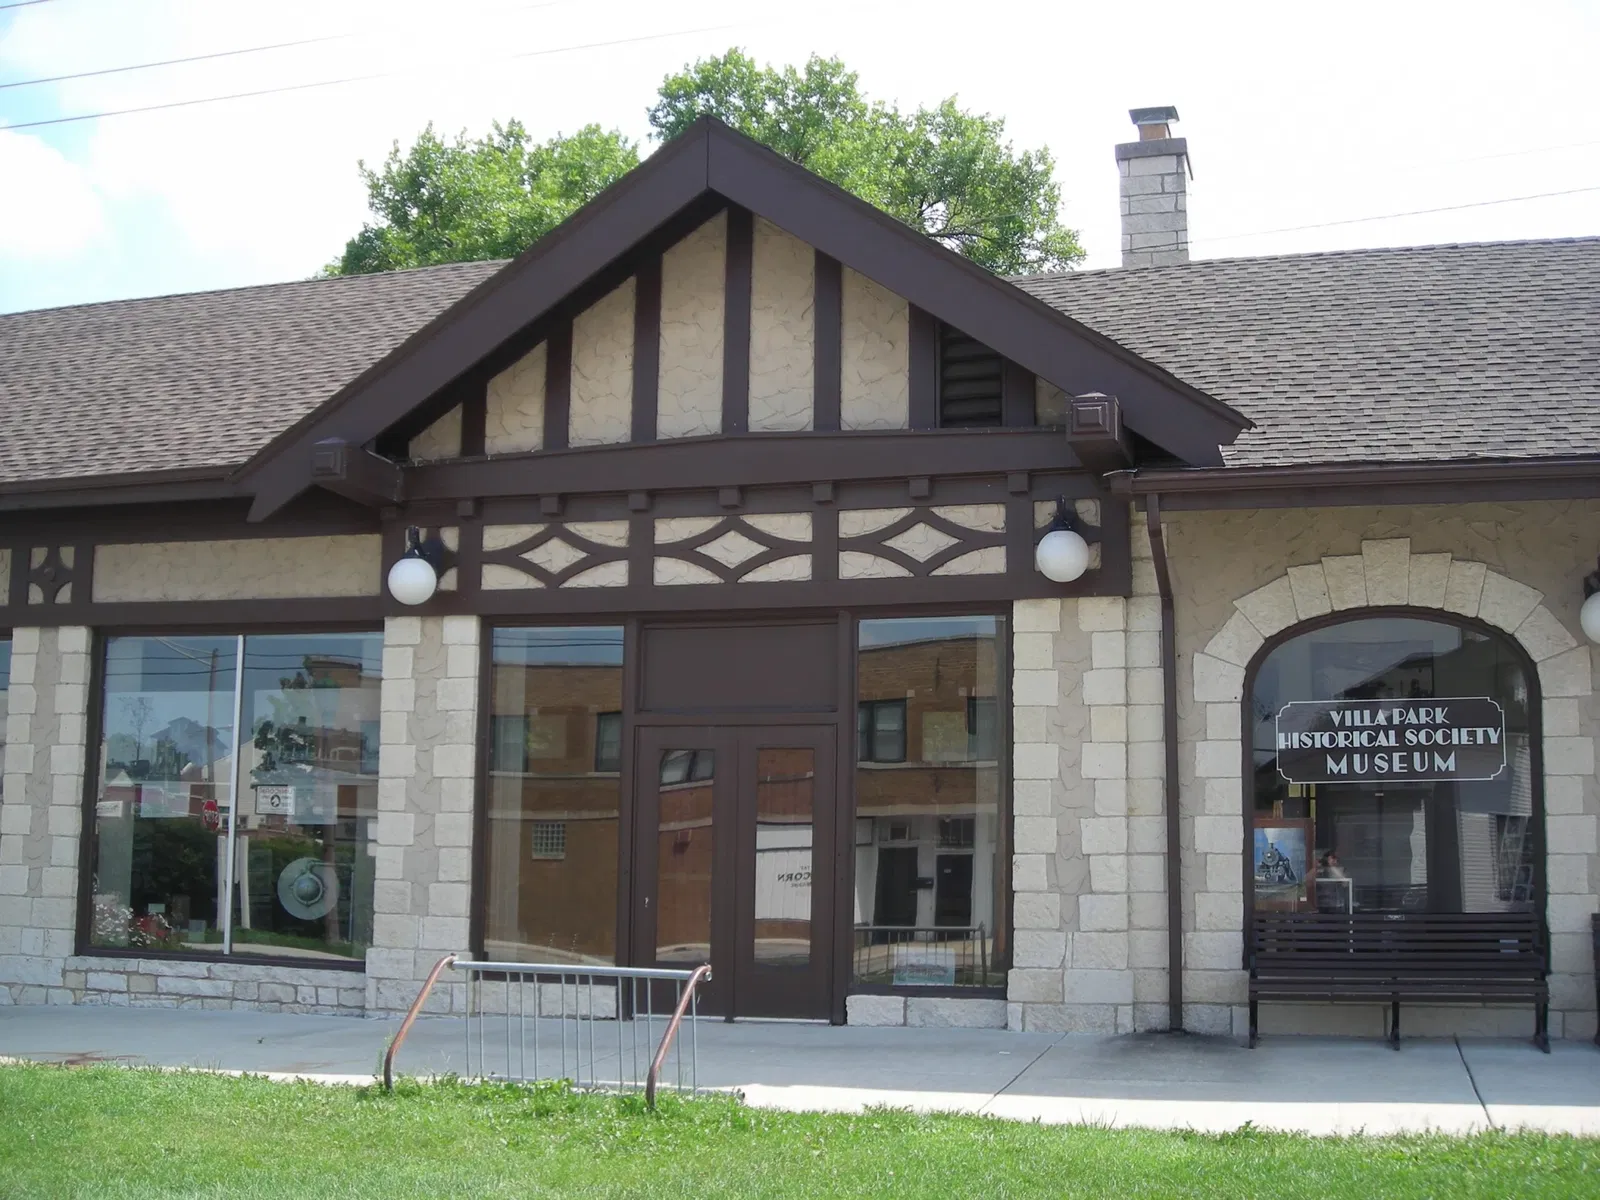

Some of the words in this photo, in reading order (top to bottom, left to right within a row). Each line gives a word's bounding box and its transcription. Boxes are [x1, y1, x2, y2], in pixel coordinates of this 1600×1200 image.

[1329, 709, 1388, 728] VILLA
[1392, 707, 1450, 725] PARK
[1278, 729, 1399, 749] HISTORICAL
[1404, 727, 1501, 746] SOCIETY
[1326, 751, 1456, 775] MUSEUM
